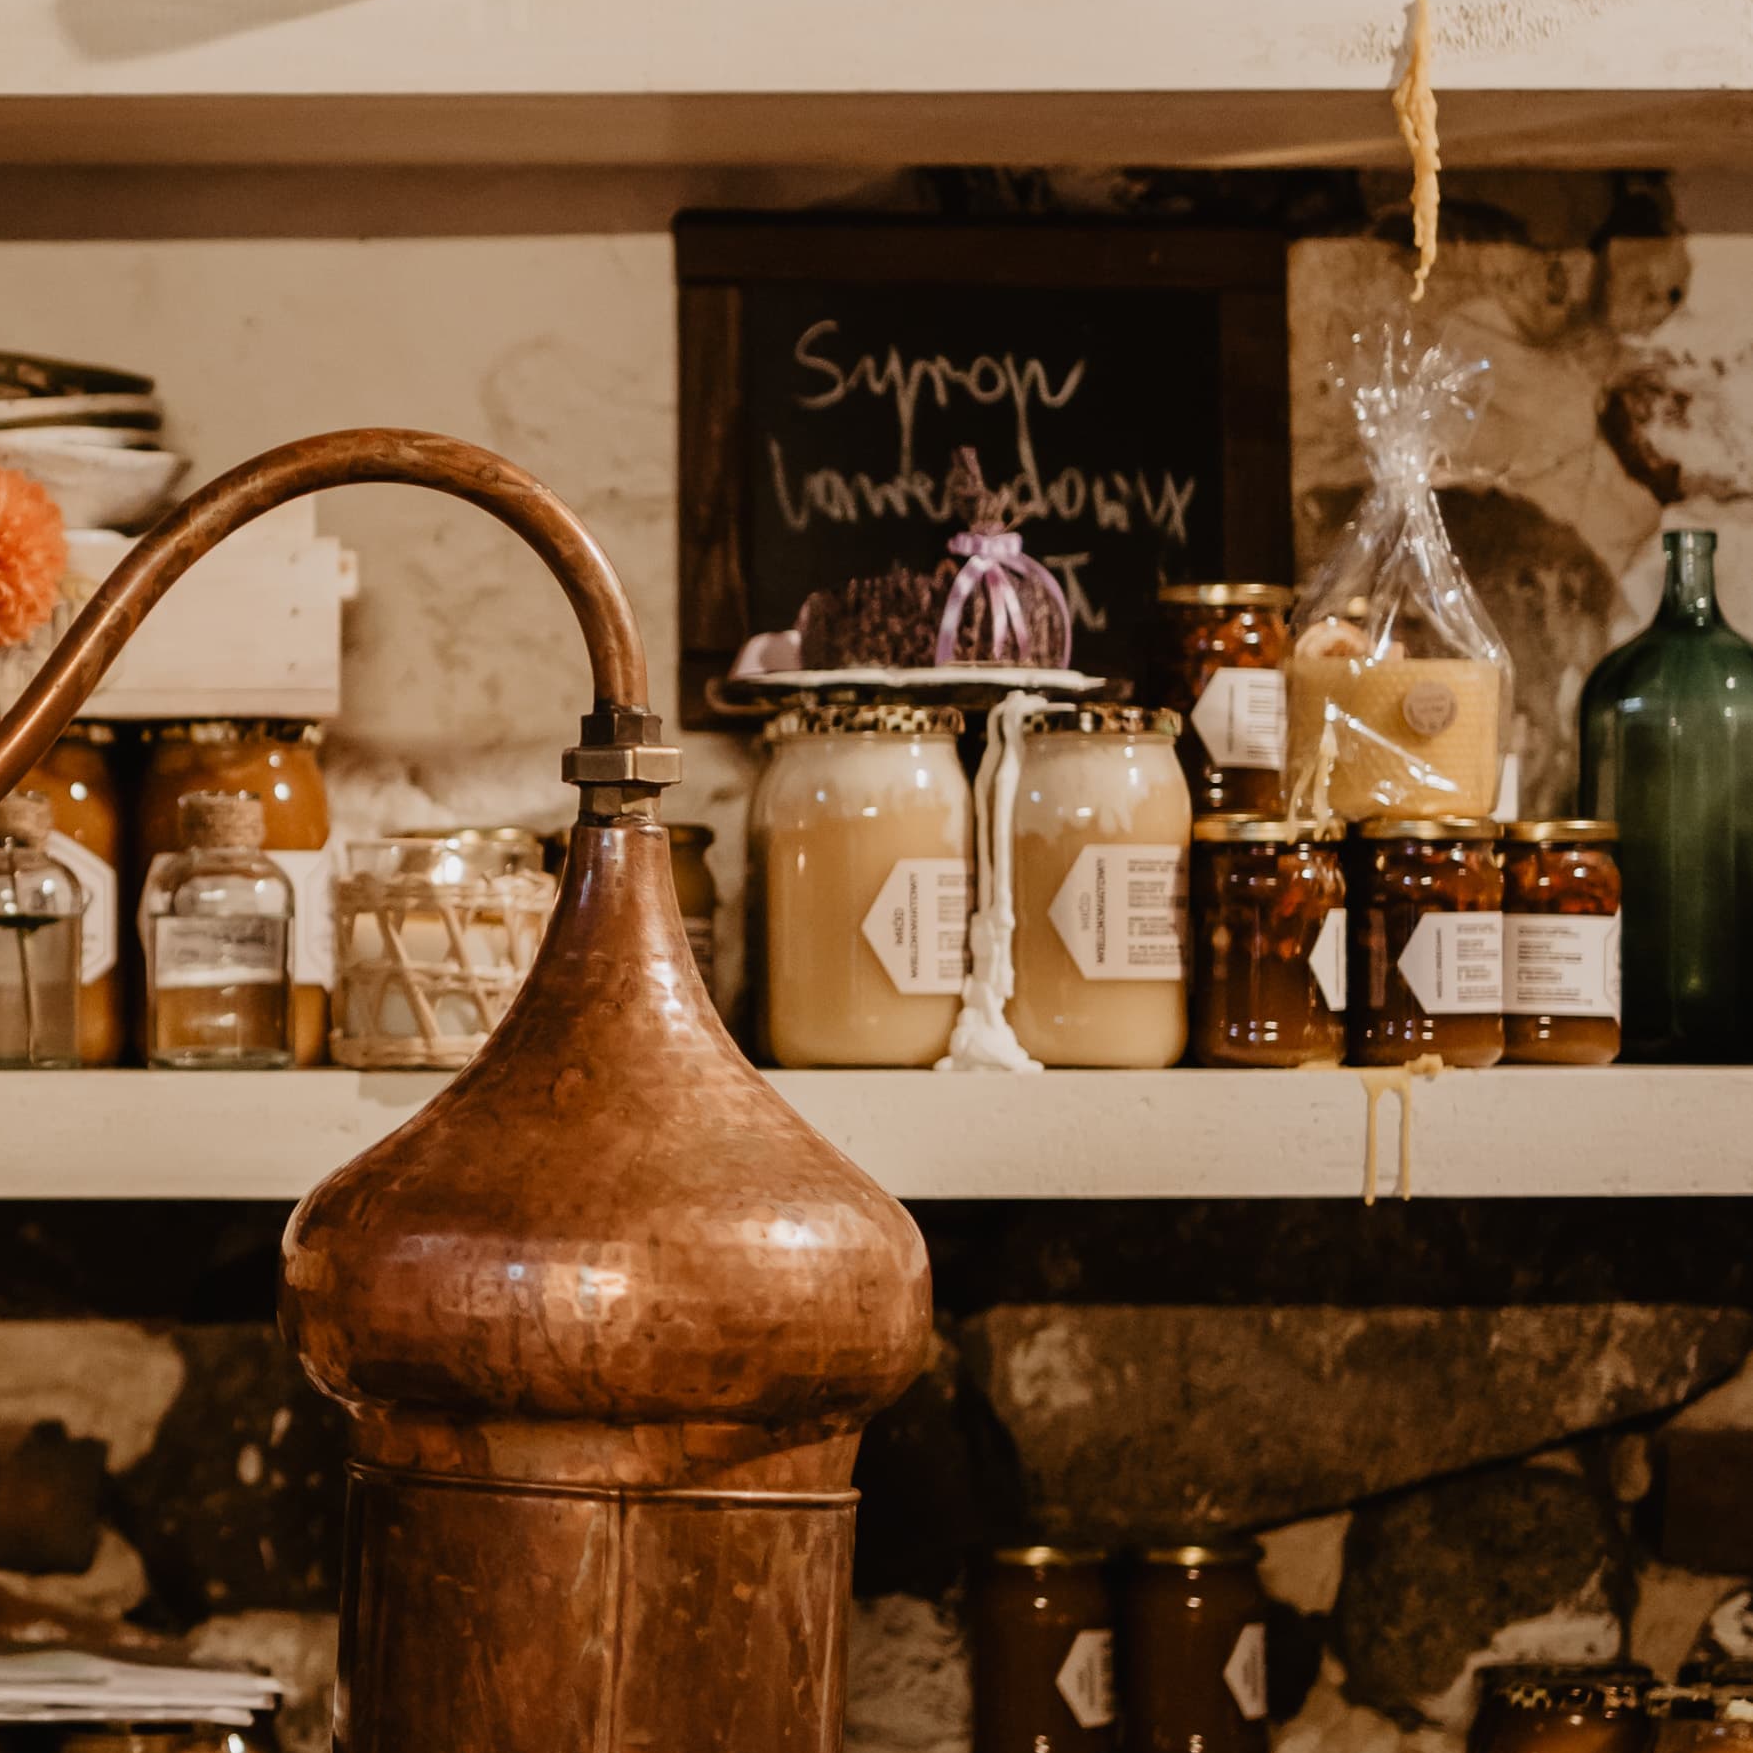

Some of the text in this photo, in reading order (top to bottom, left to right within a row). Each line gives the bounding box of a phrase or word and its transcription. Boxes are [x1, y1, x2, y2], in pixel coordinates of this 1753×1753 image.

[892, 907, 904, 947] MIÓD
[909, 873, 919, 979] WIELOKWIATOWY
[1095, 857, 1106, 965] WIELOKWIATOWY
